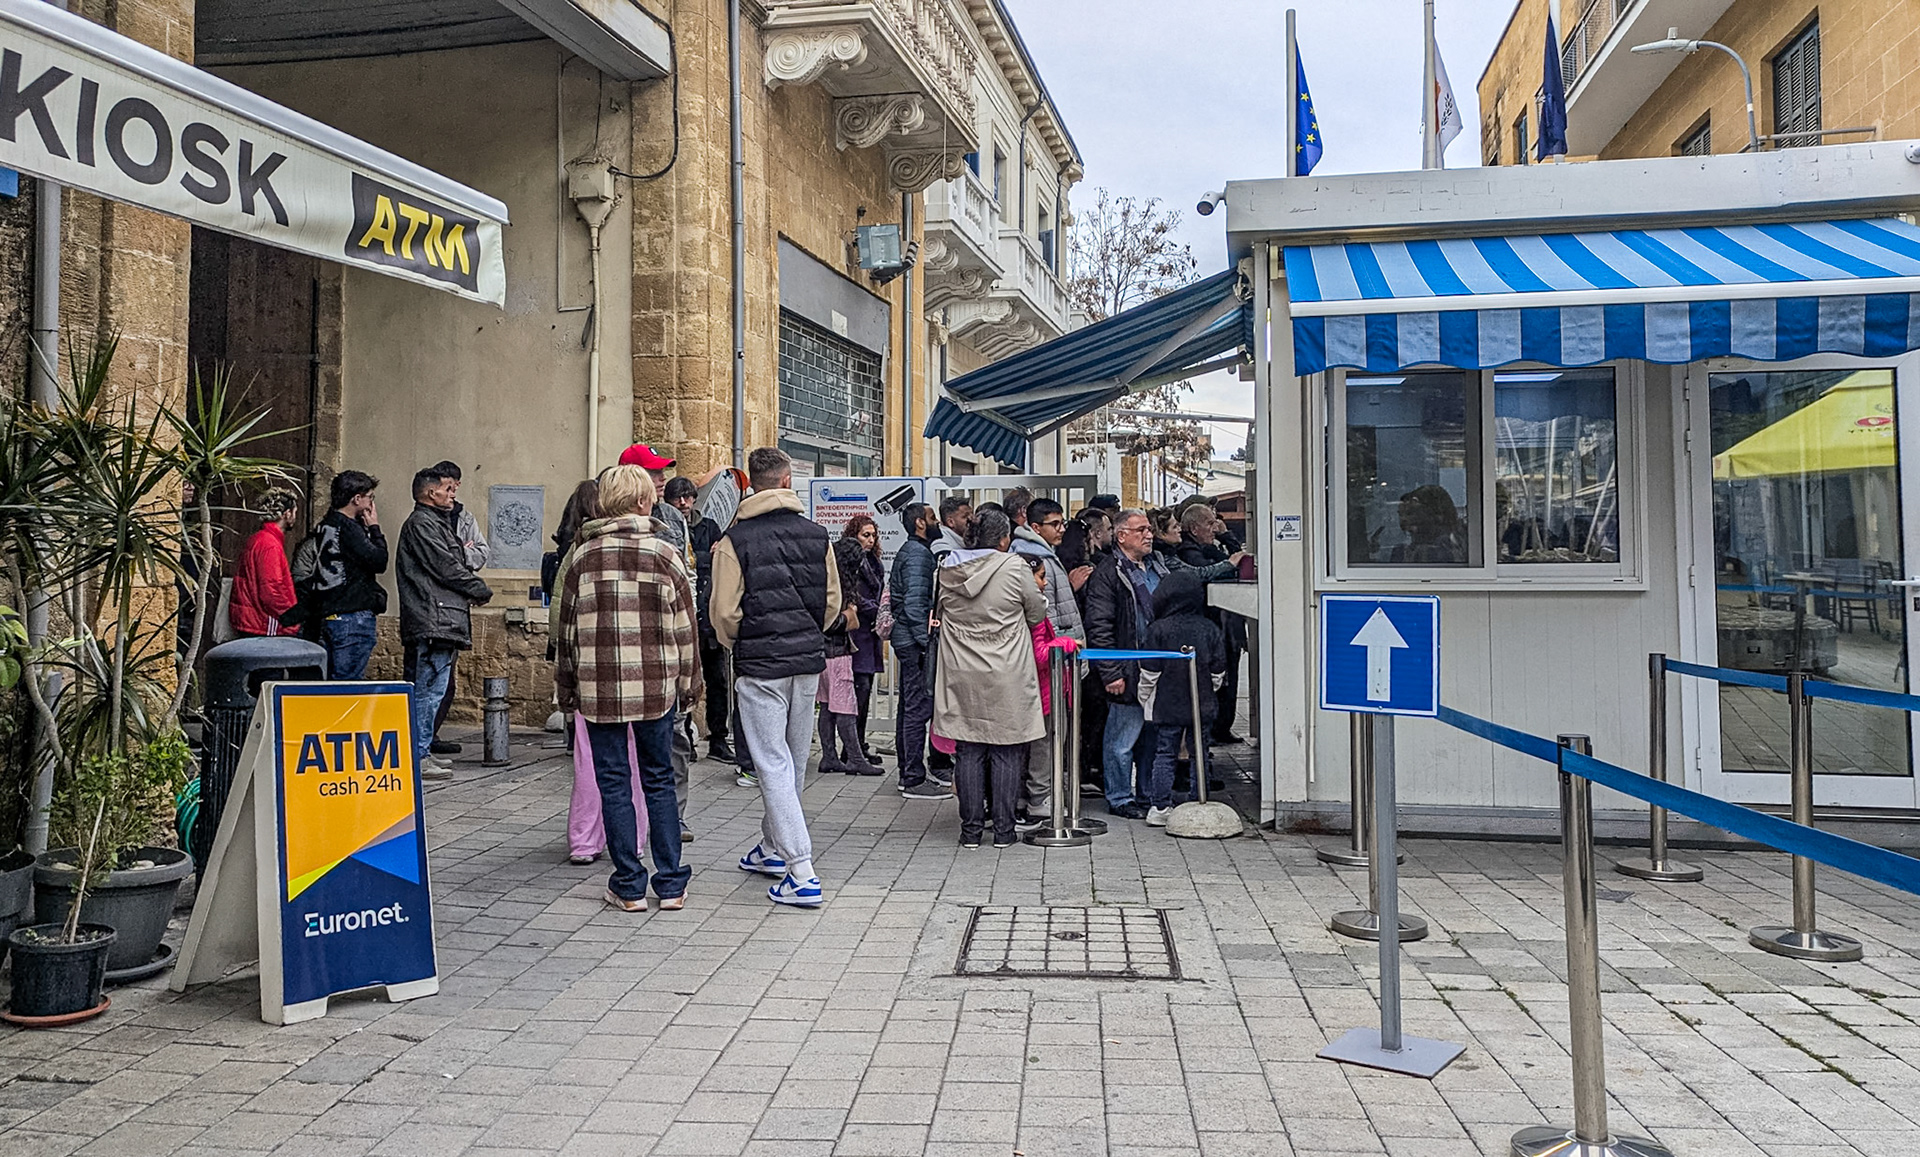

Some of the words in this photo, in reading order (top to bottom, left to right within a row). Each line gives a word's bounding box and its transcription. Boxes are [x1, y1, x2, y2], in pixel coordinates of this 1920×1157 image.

[0, 47, 290, 227] KIOSK
[358, 194, 472, 276] ATM
[297, 731, 401, 774] ATM
[319, 776, 360, 797] cash
[365, 773, 403, 795] 24h
